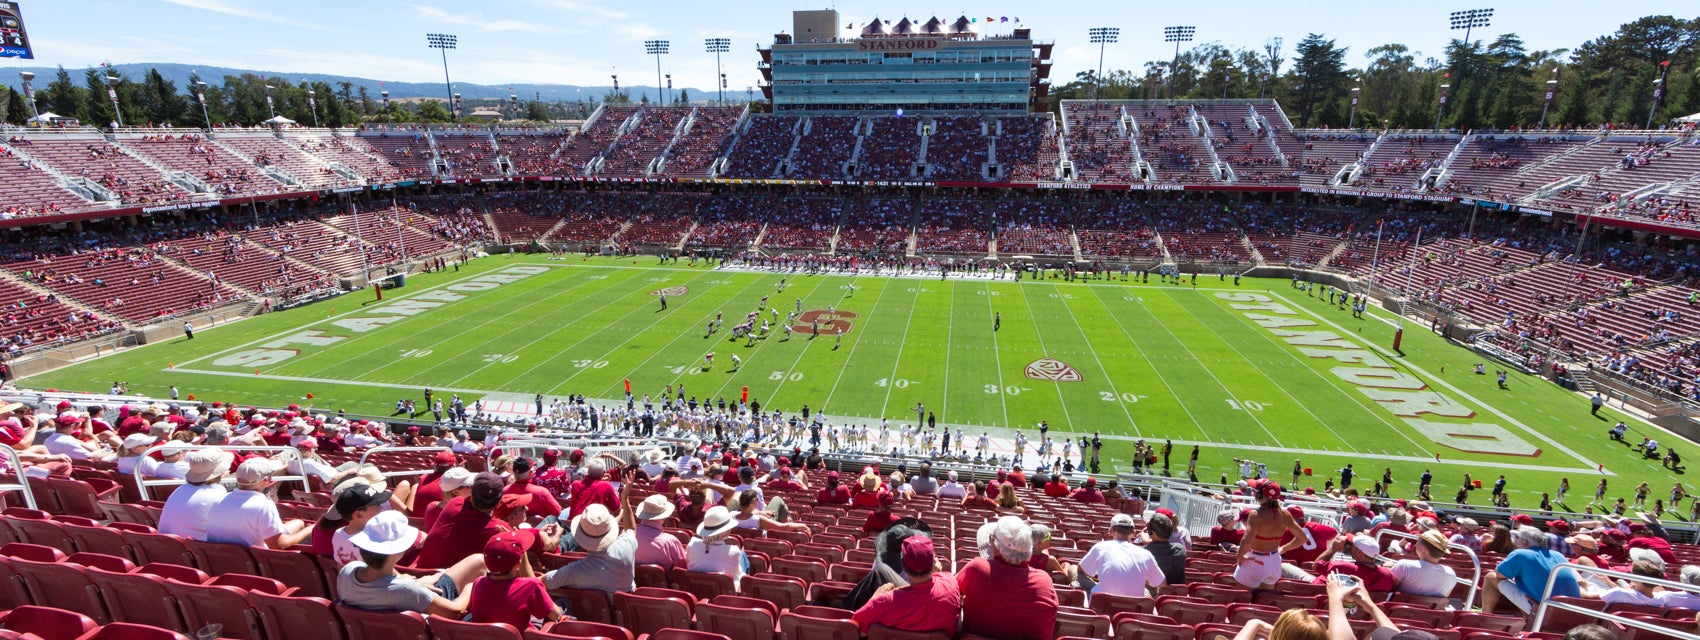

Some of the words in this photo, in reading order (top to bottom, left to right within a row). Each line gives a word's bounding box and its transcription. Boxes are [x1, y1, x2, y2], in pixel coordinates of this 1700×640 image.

[860, 40, 938, 50] STANFORD
[212, 265, 553, 368] STANFORD
[791, 309, 861, 336] S
[403, 349, 434, 358] 10
[487, 354, 520, 363] 20
[575, 359, 610, 369] 30
[669, 364, 702, 375] 40
[768, 371, 804, 382] 50
[1213, 291, 1543, 458] STANFORD
[874, 378, 911, 389] 40
[984, 384, 1022, 396] 30
[1099, 391, 1141, 403] 20
[1225, 398, 1264, 412] 10
